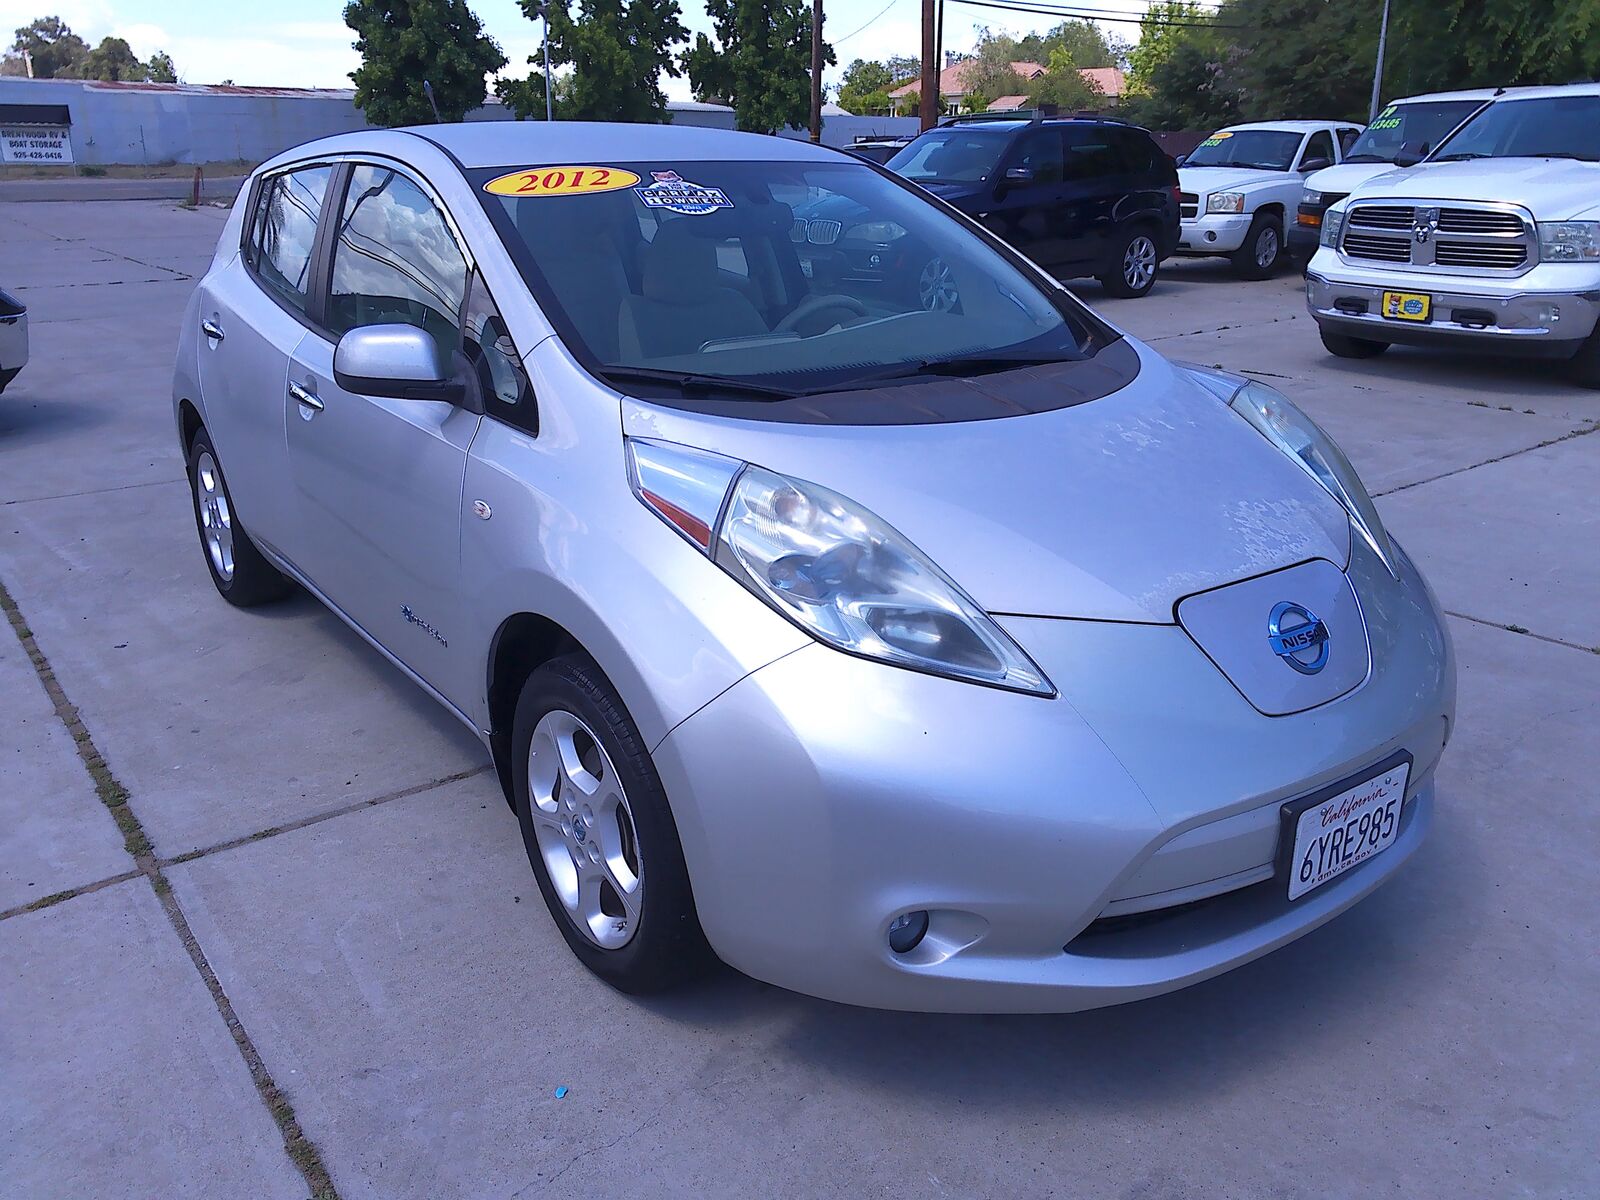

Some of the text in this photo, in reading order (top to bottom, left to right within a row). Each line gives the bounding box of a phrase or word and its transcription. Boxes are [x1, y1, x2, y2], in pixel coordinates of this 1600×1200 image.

[1, 131, 67, 139] BRENTWOOD RV &
[9, 140, 63, 149] BOAT STORAGE
[516, 169, 610, 193] 2012
[643, 189, 720, 198] CARFAX
[662, 197, 725, 205] OWNER
[1321, 786, 1389, 828] California
[1299, 798, 1398, 883] 6YRE985
[1317, 849, 1372, 882] dmv.ca.gov
